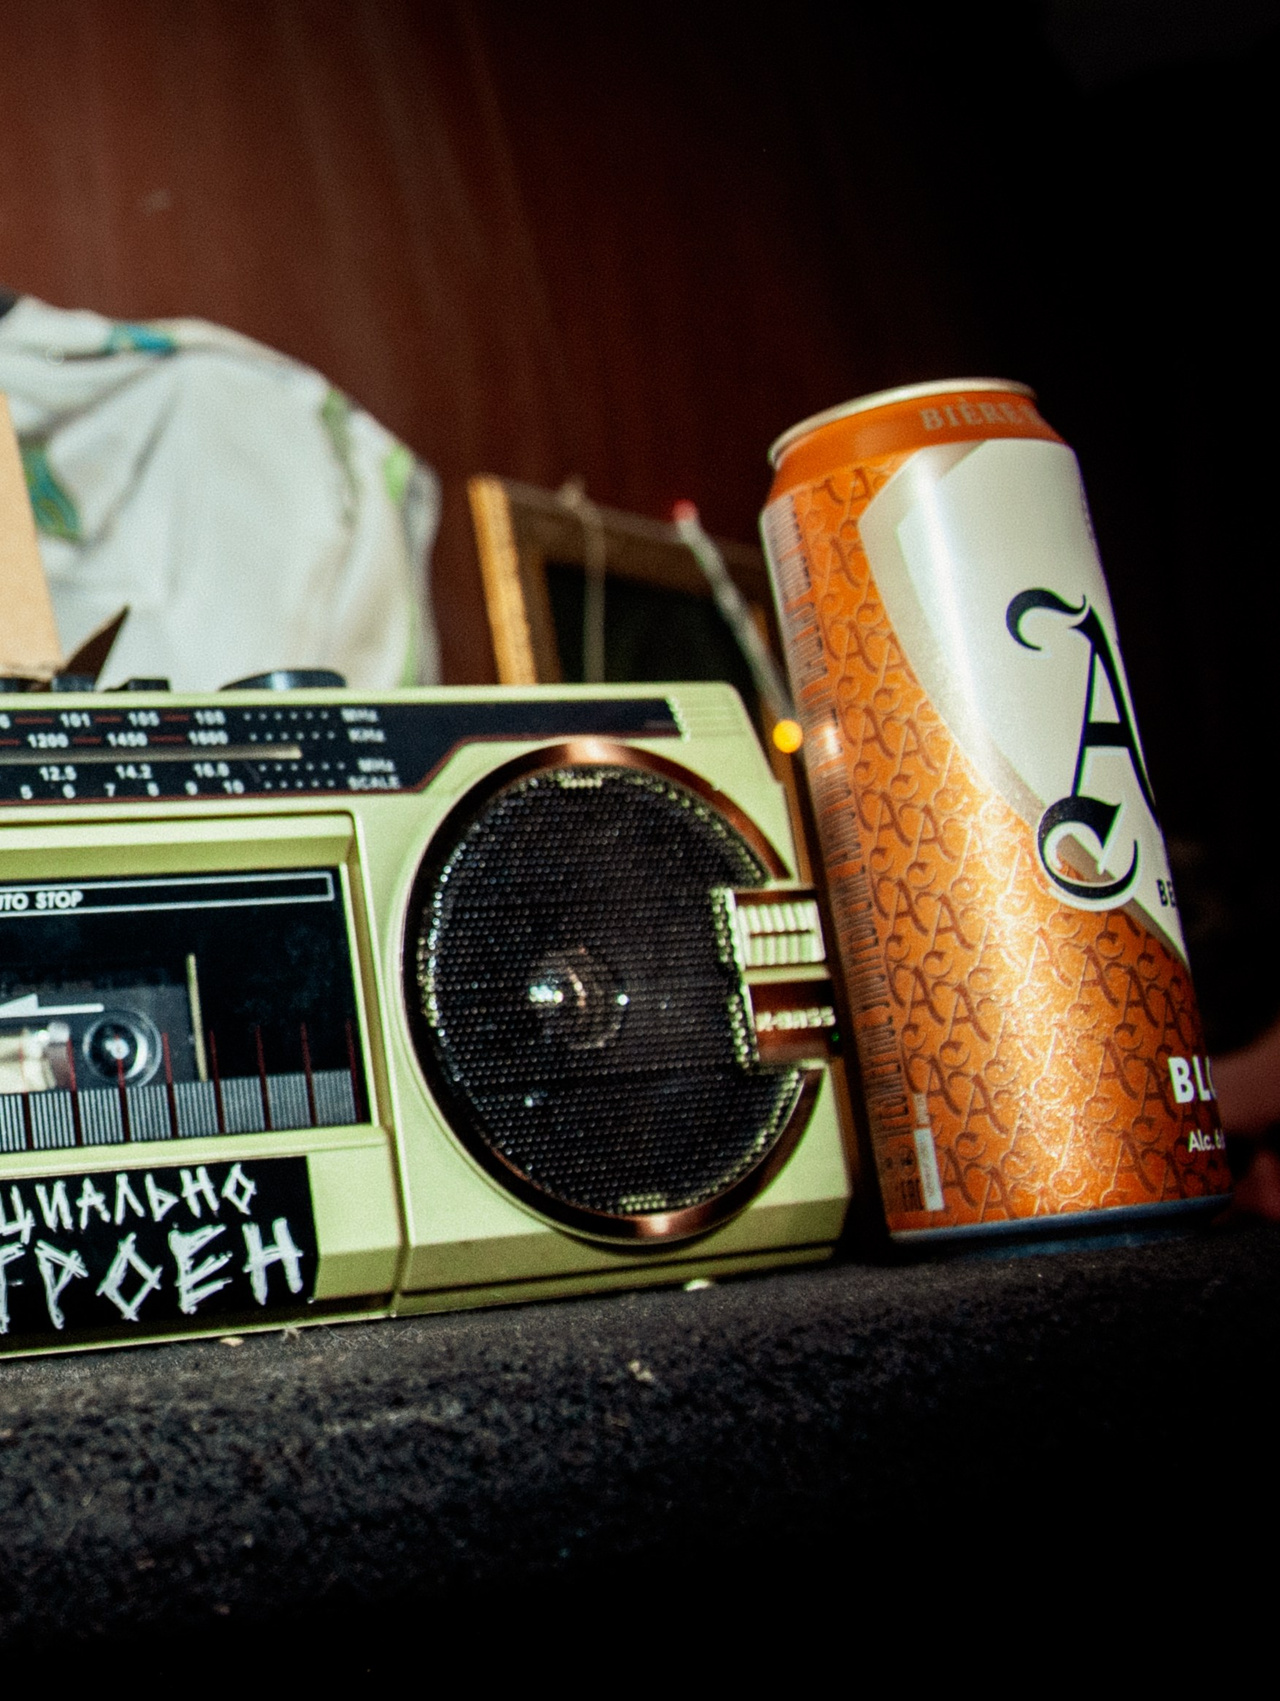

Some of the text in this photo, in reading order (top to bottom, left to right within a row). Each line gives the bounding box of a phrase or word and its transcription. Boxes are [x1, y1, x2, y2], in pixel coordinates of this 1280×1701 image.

[60, 711, 91, 728] 101
[27, 732, 69, 749] 1200
[115, 763, 153, 780] 14.2
[19, 784, 34, 800] 5
[62, 783, 77, 799] 6
[103, 782, 116, 798] 7
[146, 780, 160, 797] 8
[184, 780, 199, 796] 9
[221, 778, 245, 795] 10
[34, 890, 84, 909] STOP
